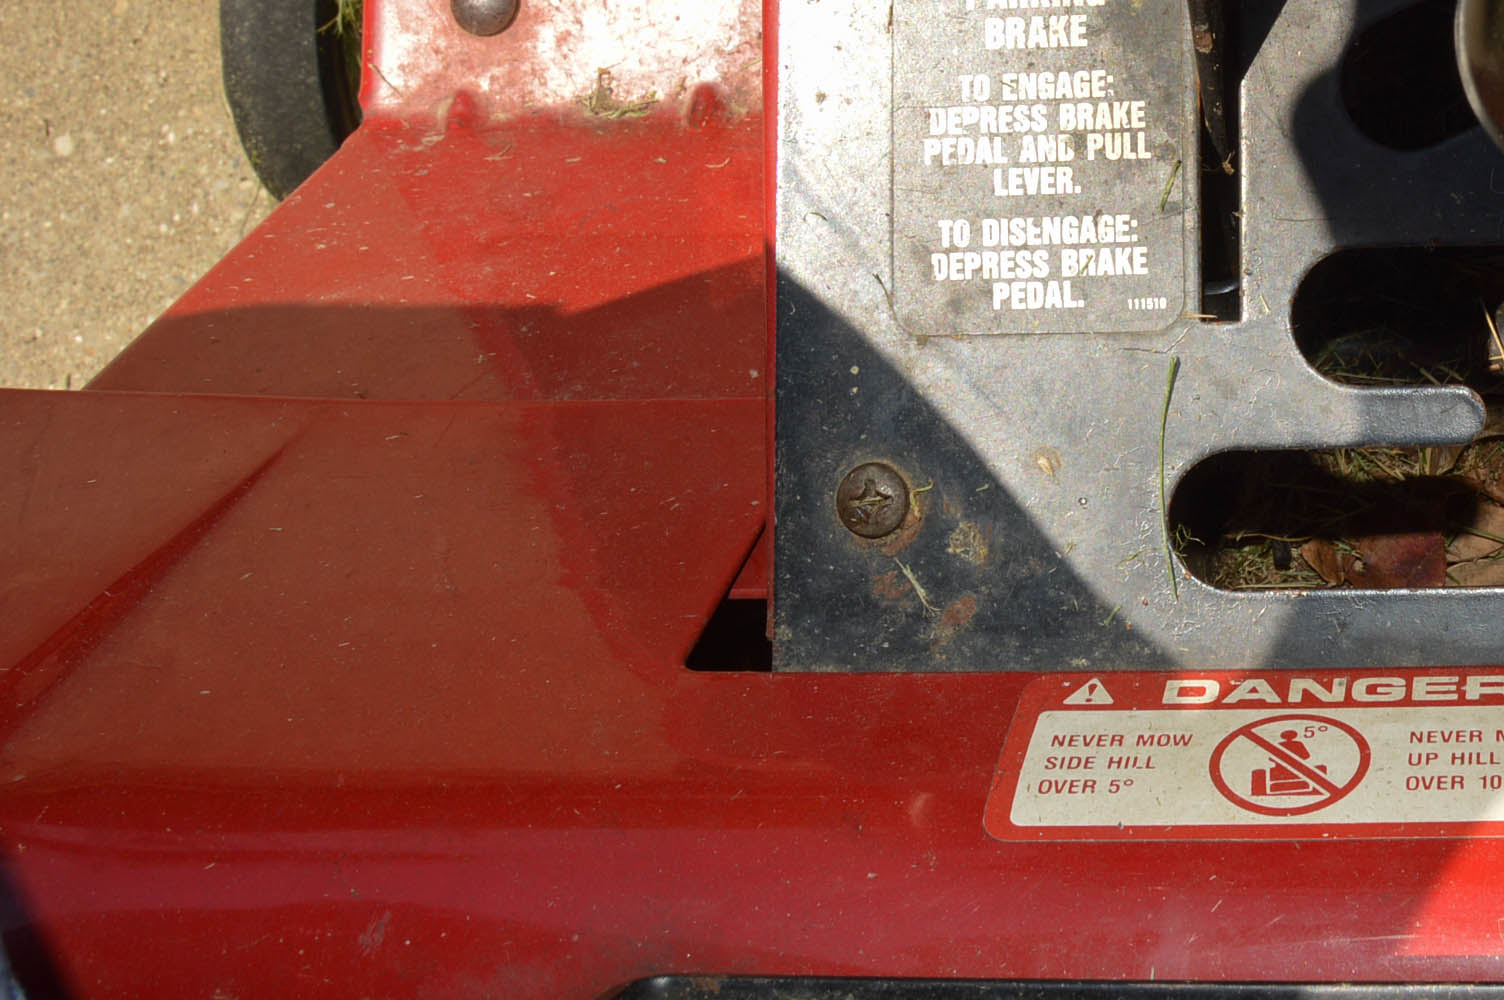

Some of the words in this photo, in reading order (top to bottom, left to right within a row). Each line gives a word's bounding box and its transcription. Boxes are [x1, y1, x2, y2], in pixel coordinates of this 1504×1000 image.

[984, 14, 1088, 50] BRAKE
[959, 72, 991, 102] TO
[1002, 69, 1114, 101] ENGAGE:
[928, 103, 1048, 136] DEPRESS
[1059, 100, 1146, 132] BRAKE
[923, 135, 1009, 166] PEDAL
[1019, 133, 1075, 164] AND
[1087, 130, 1152, 162] PULL
[992, 165, 1082, 198] LEVER.
[938, 218, 970, 249] TO
[982, 214, 1139, 248] DISENGAGE:
[931, 249, 1050, 282] DEPRESS
[1061, 246, 1149, 278] BRAKE
[992, 280, 1085, 311] PEDAL.
[1051, 733, 1126, 749] NEVER
[1136, 732, 1194, 748] MOW
[1303, 725, 1329, 740] 5°
[1409, 729, 1483, 745] NEVER
[1044, 755, 1096, 771] SIDE
[1107, 754, 1156, 770] HILL
[1407, 751, 1441, 767] UP
[1451, 750, 1501, 766] HILL
[1038, 778, 1096, 795] OVER
[1108, 778, 1135, 795] 5°
[1405, 775, 1464, 792] OVER
